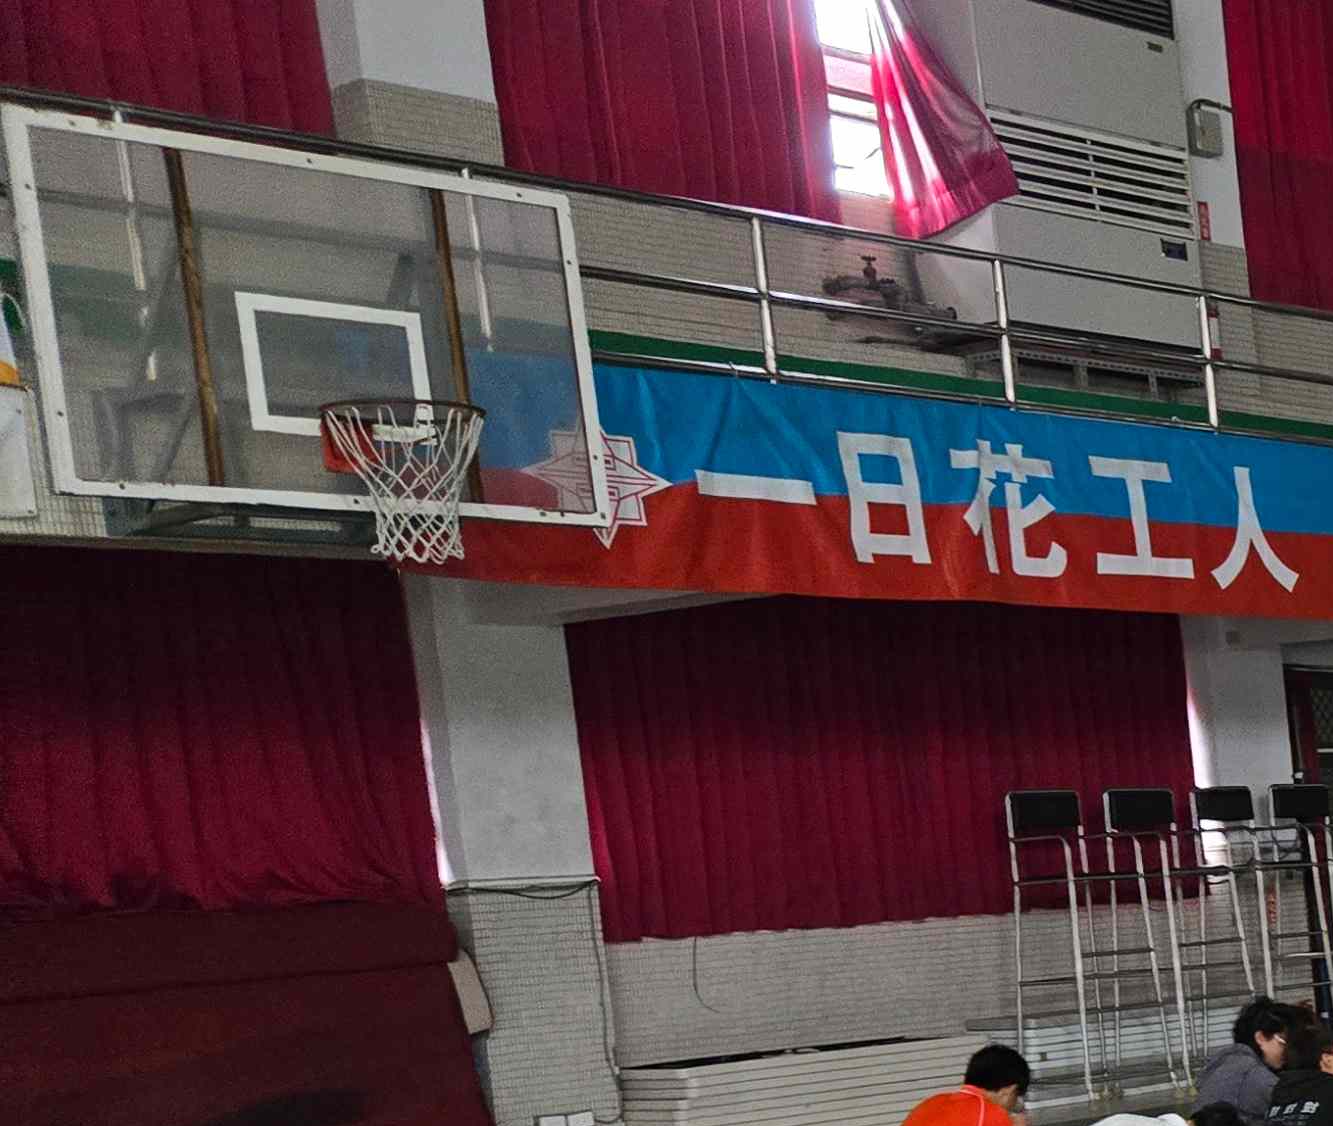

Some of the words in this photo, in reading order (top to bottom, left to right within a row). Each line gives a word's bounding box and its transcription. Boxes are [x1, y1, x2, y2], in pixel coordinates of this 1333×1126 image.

[695, 431, 1299, 593] 一日花工人
